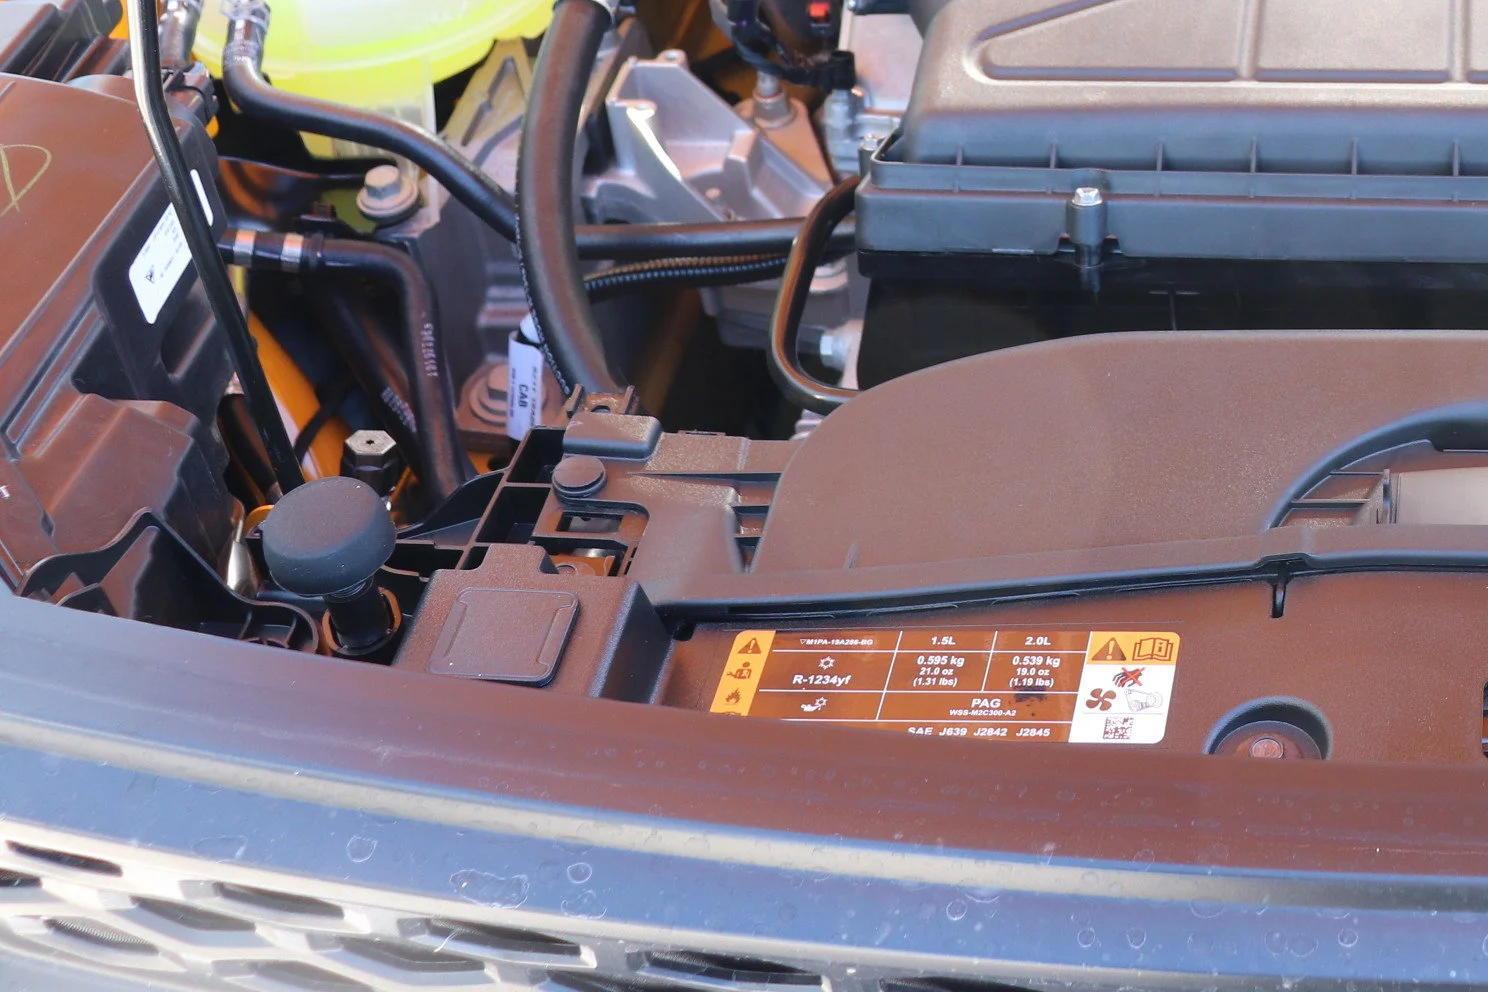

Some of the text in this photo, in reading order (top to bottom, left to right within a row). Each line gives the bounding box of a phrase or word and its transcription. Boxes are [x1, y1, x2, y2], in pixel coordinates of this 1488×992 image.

[931, 636, 956, 646] 1.5L
[1025, 636, 1051, 646] 2.0L
[917, 655, 965, 667] 0.595 kg
[1012, 655, 1060, 667] 0.539 kg
[919, 667, 940, 676] 21.0
[1016, 667, 1036, 676] 19.0
[792, 674, 852, 687] R-1234yf
[913, 677, 958, 688] (1.31 lbs)
[1009, 677, 1054, 688] (1.19 lbs)
[971, 698, 1001, 708] PAG
[907, 727, 1051, 737] SAE J639 J2842 J2845
